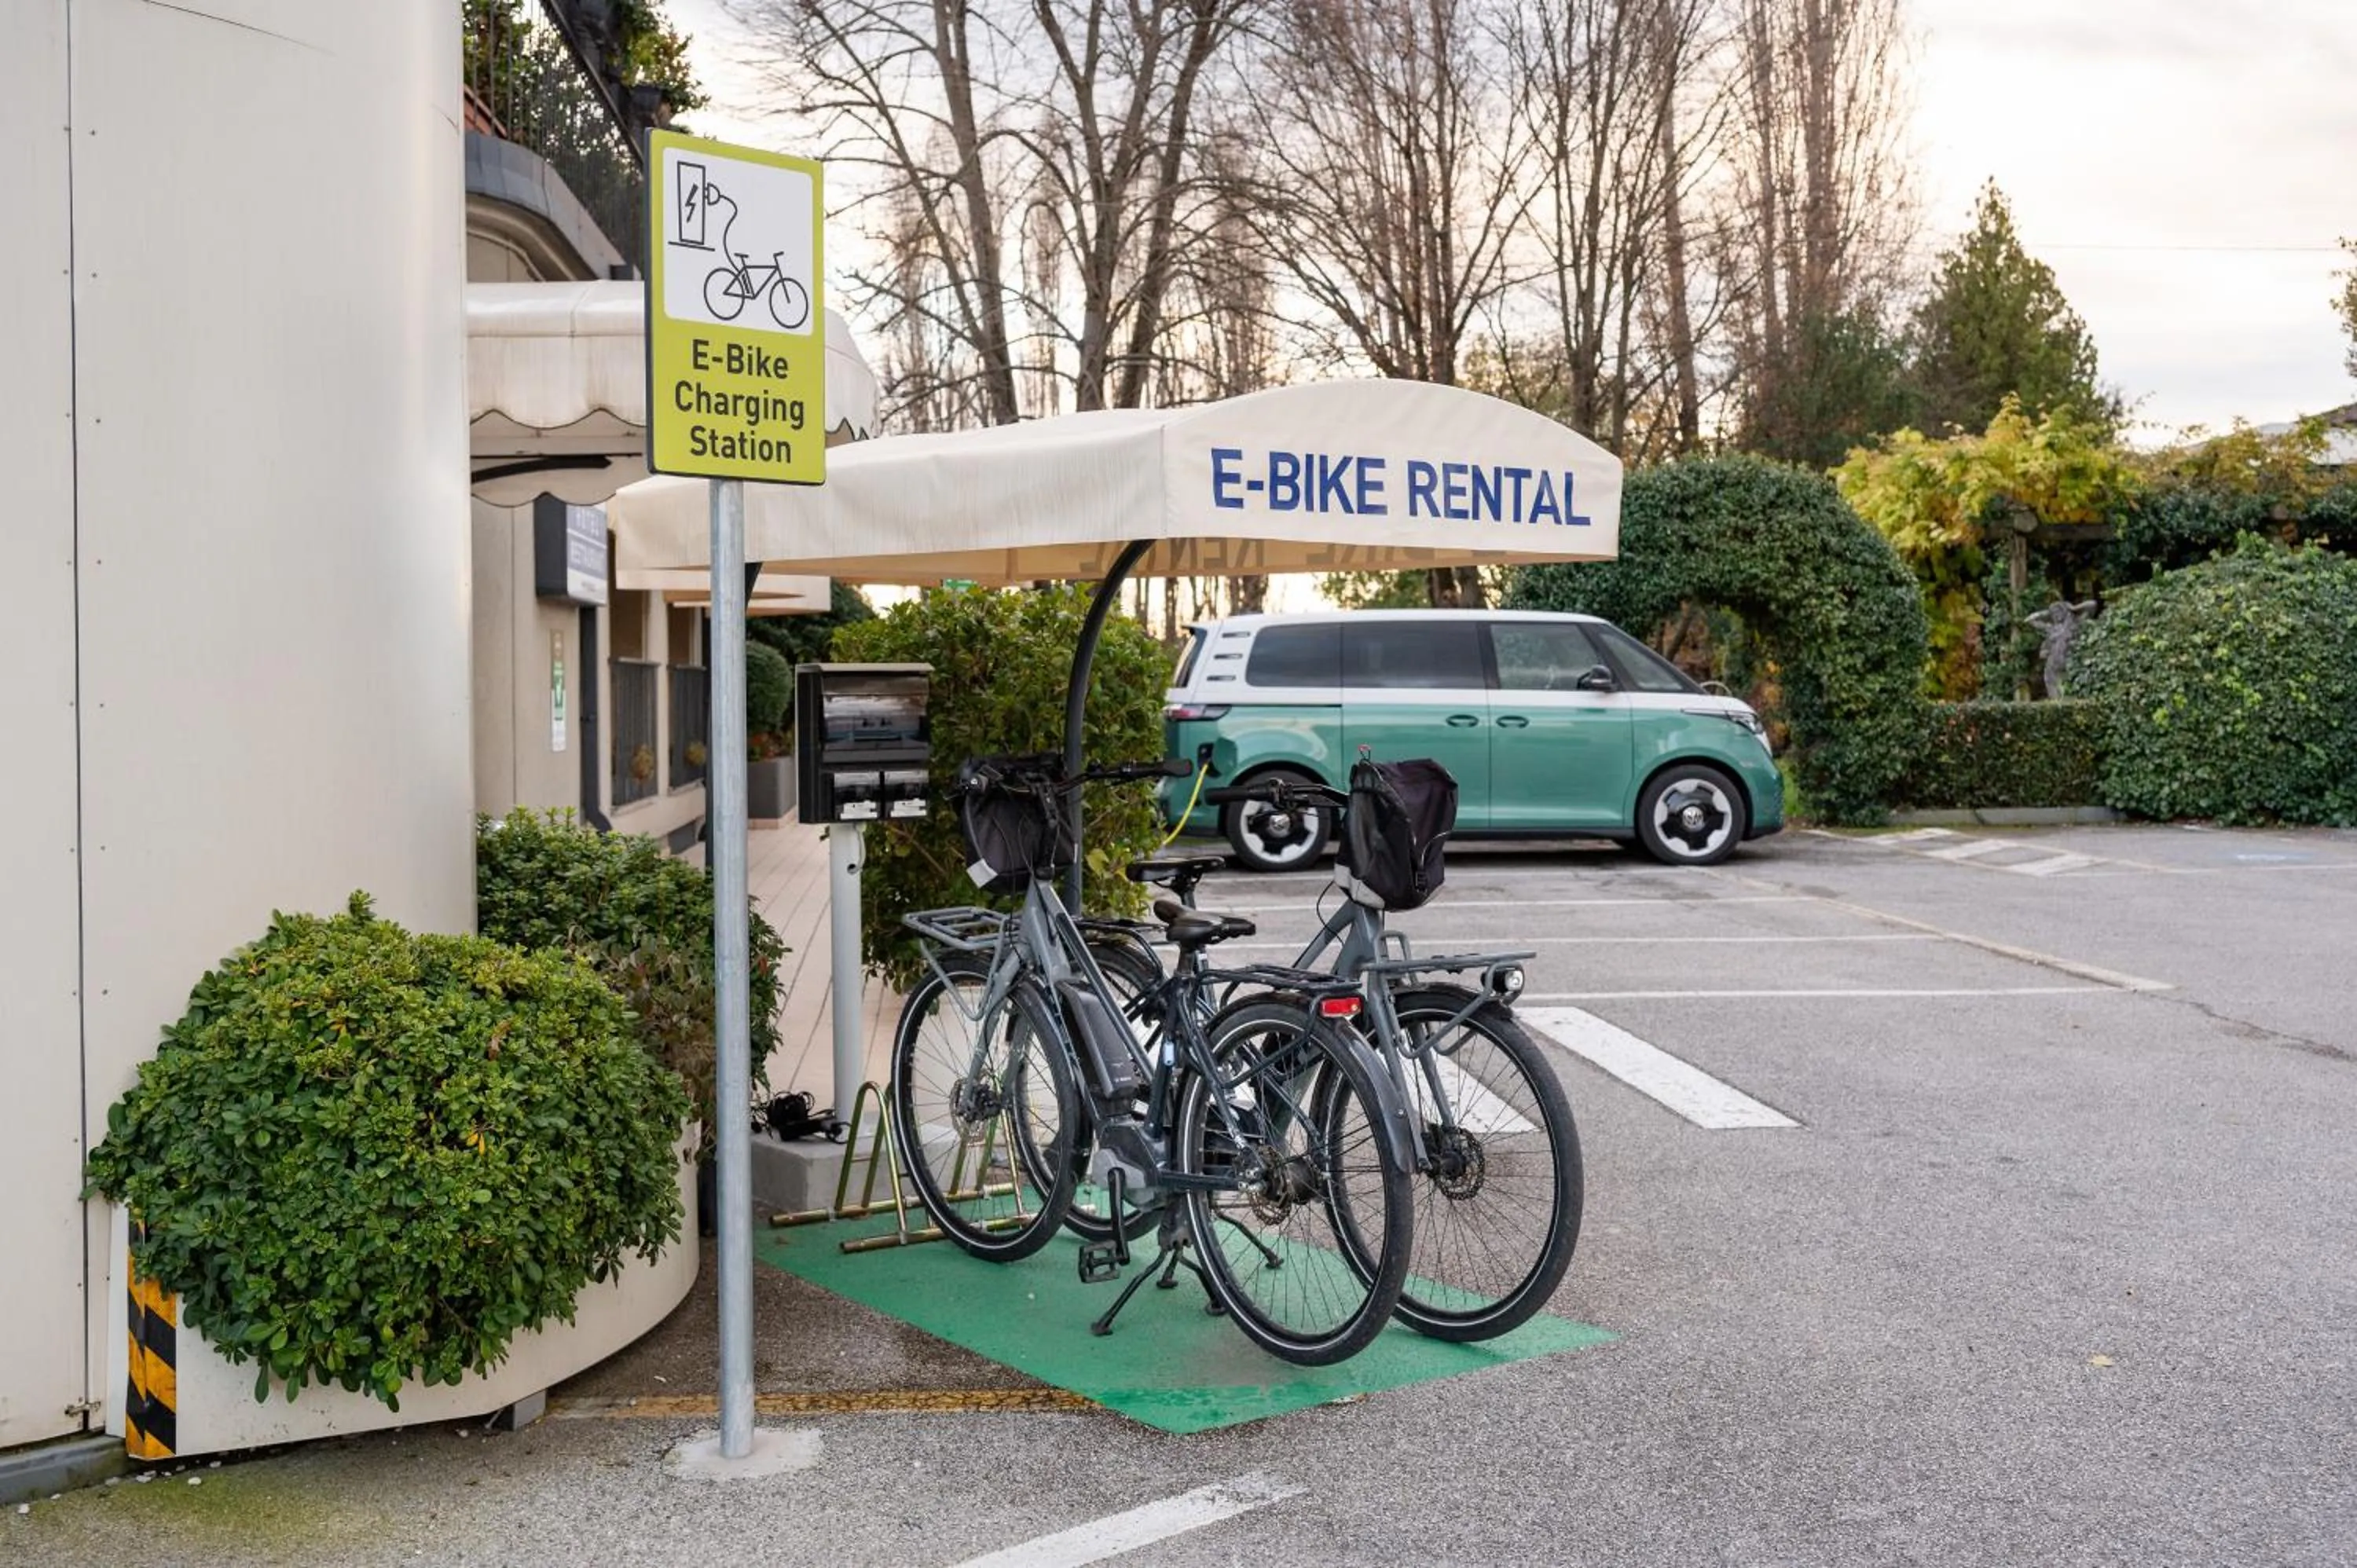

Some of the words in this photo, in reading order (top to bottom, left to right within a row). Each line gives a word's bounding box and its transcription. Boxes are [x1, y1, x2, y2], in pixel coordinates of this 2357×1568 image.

[692, 339, 789, 379] E-Bike
[675, 379, 805, 430] Charging
[690, 425, 791, 463] Station
[1211, 448, 1387, 515] E-BIKE
[1407, 460, 1591, 526] RENTAL
